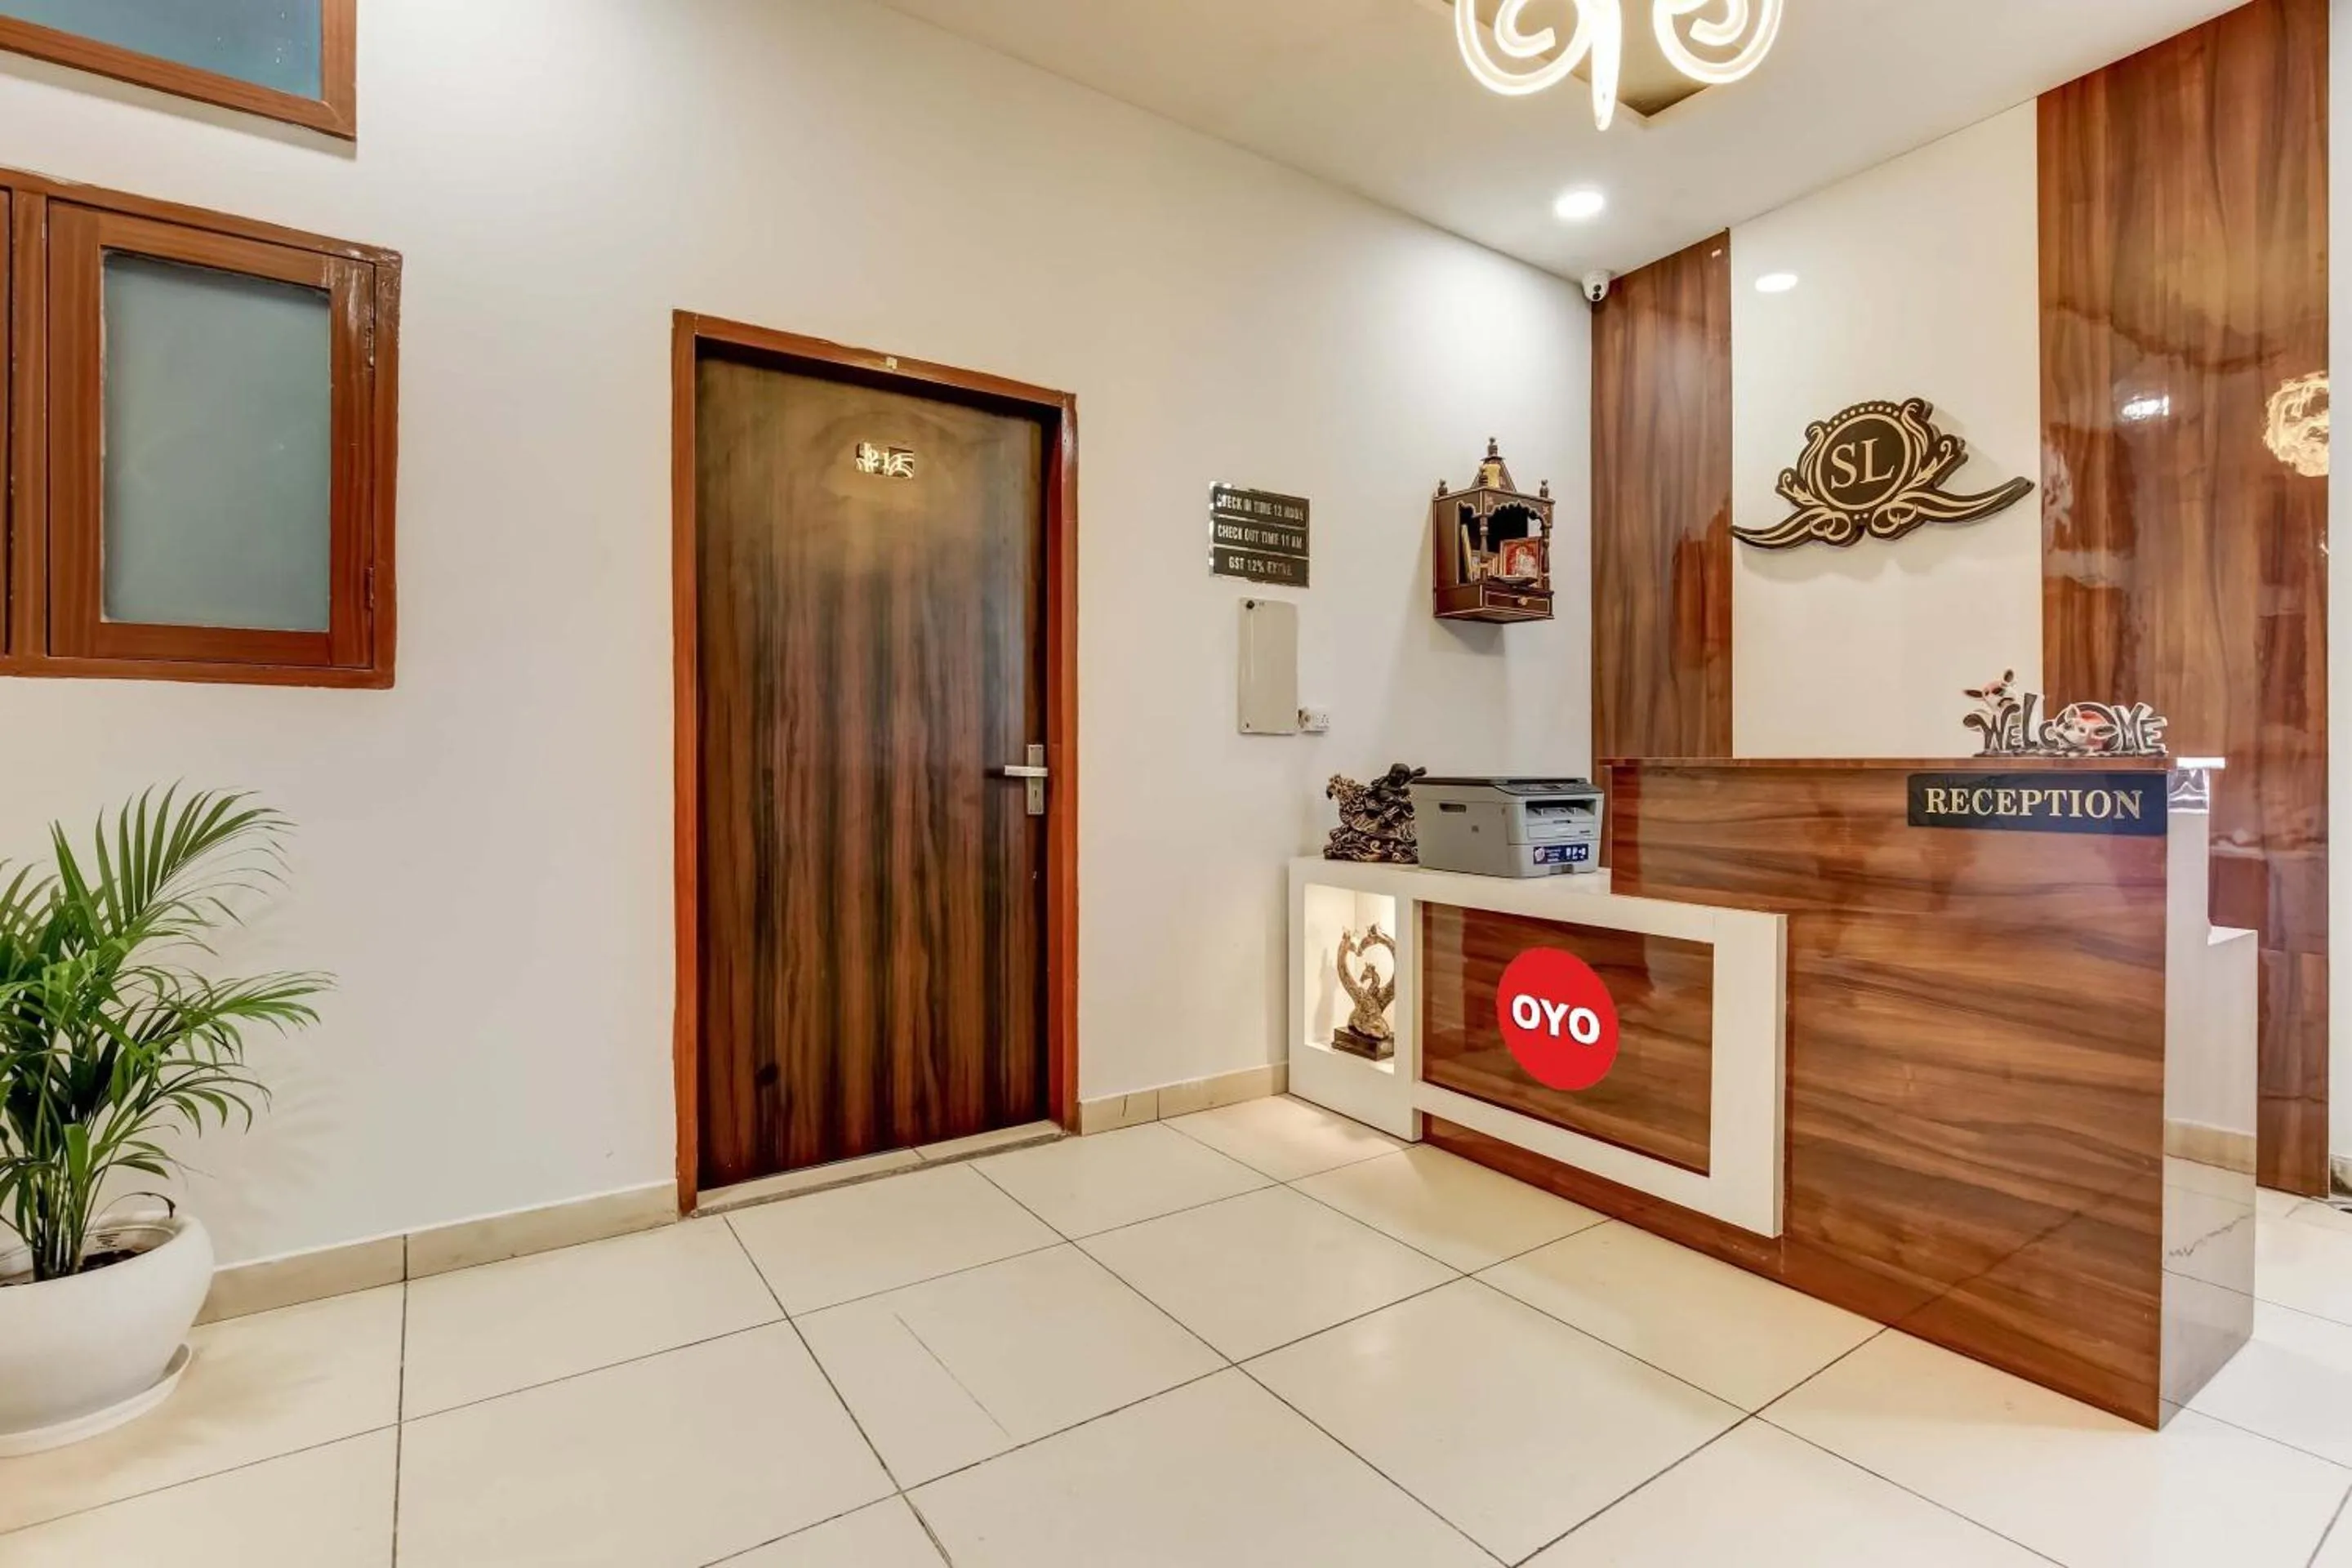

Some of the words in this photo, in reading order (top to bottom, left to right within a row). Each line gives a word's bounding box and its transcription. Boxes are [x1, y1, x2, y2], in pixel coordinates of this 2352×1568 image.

[1830, 438, 1895, 490] SL
[1218, 523, 1242, 540] CHECK
[1244, 528, 1259, 542] OUT
[1261, 531, 1280, 545] TIME
[1291, 536, 1303, 549] AM
[1228, 556, 1245, 569] GST
[1247, 559, 1265, 573] 12%
[1962, 693, 2168, 751] WELCOME
[1924, 786, 2144, 820] RECEPTION
[1512, 994, 1601, 1046] OYO
